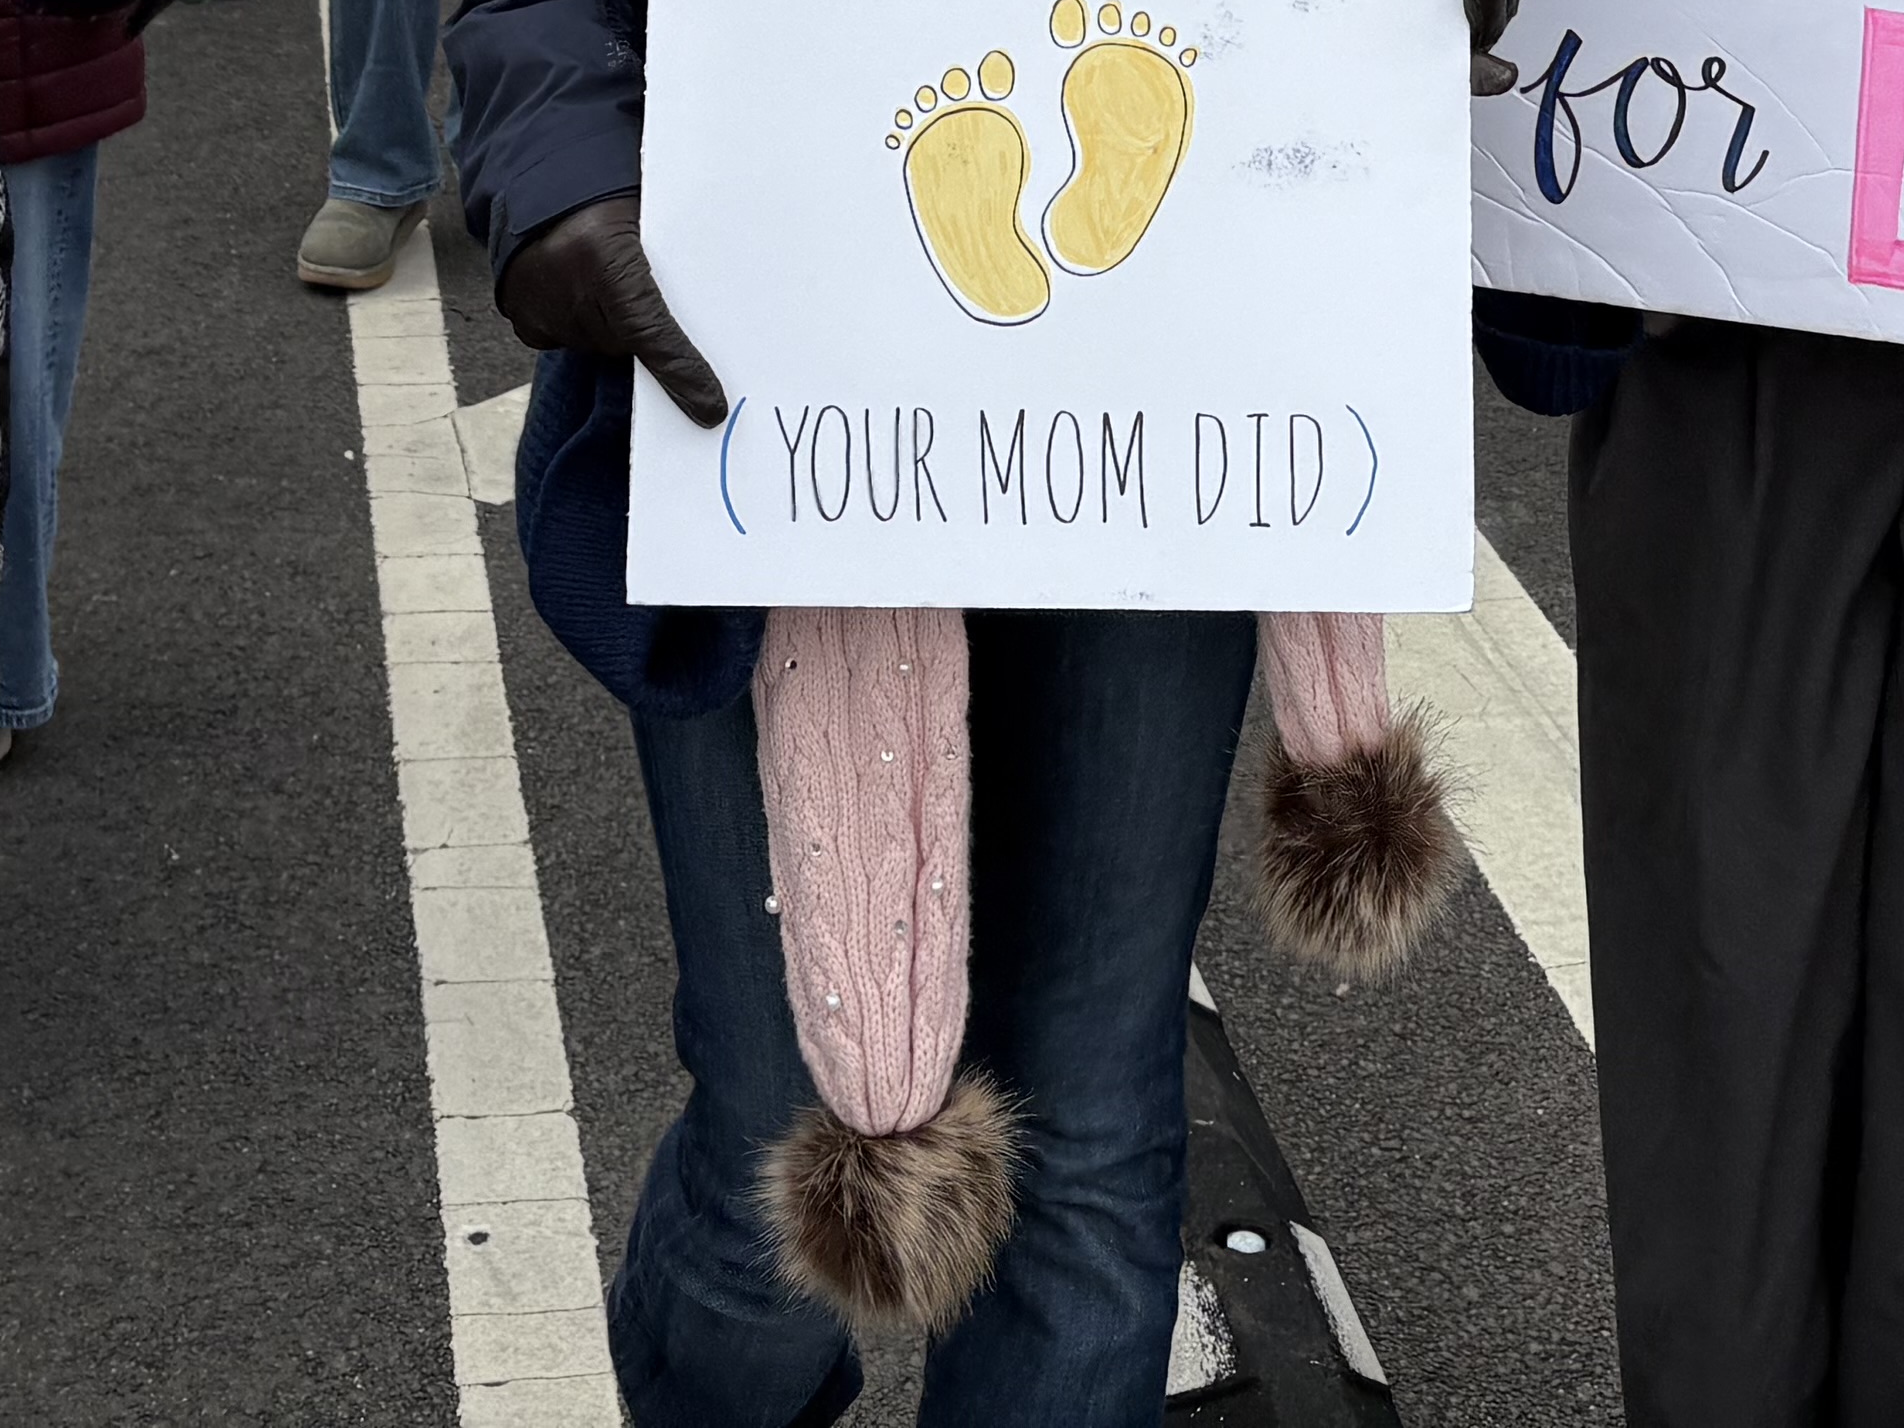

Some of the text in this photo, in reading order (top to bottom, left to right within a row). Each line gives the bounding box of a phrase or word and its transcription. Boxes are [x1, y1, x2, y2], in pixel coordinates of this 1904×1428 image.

[1518, 26, 1772, 207] for
[718, 394, 1381, 537] (YOUR MOM DID)
